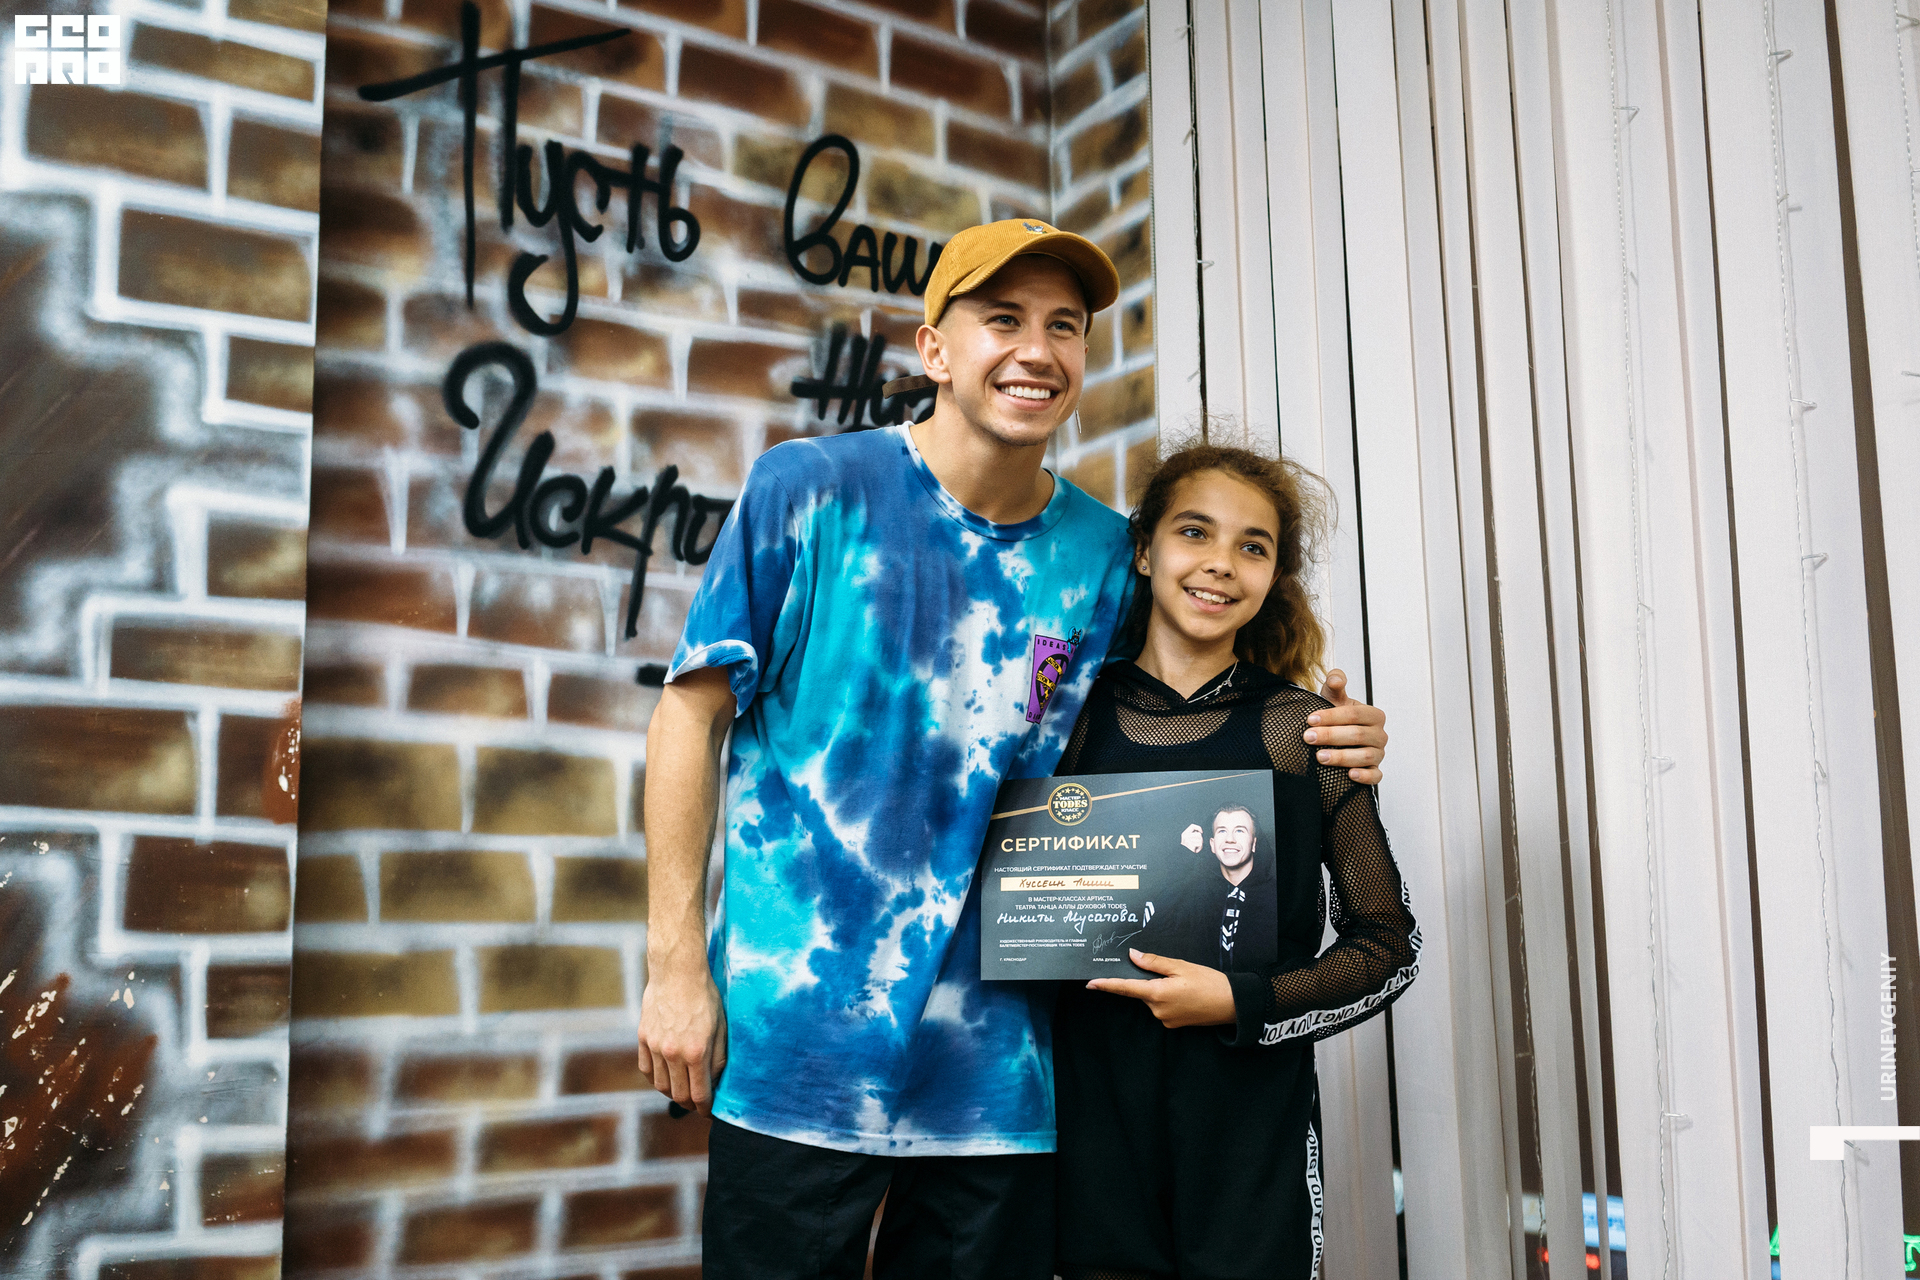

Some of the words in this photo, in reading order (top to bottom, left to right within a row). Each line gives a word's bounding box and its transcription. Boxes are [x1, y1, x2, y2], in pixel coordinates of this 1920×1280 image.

[357, 2, 700, 336] Пусть
[1037, 638, 1066, 651] IDEAS
[1053, 799, 1088, 809] TODES
[1001, 834, 1140, 853] СЕРТИФИКАТ
[994, 865, 1032, 873] НАСТОЯЩИЙ
[996, 912, 1055, 924] Никиты
